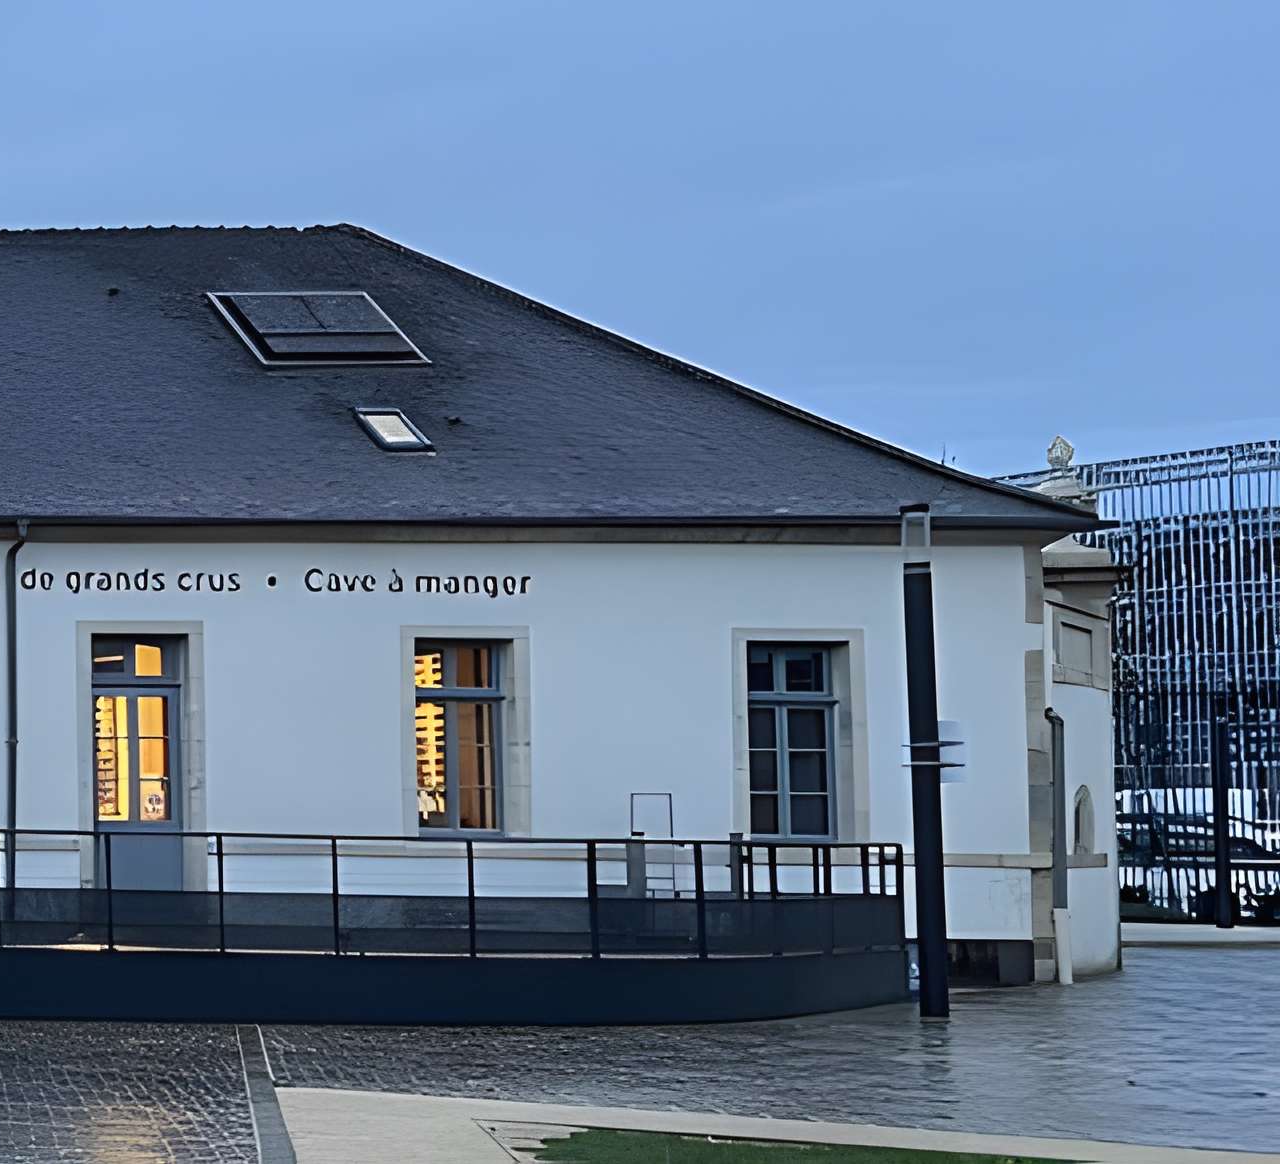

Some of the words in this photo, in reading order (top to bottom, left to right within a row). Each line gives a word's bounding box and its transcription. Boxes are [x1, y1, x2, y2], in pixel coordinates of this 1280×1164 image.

[65, 567, 166, 594] grands
[177, 572, 241, 592] crus
[304, 568, 377, 593] Cave
[388, 567, 404, 593] à
[415, 575, 532, 599] manger
